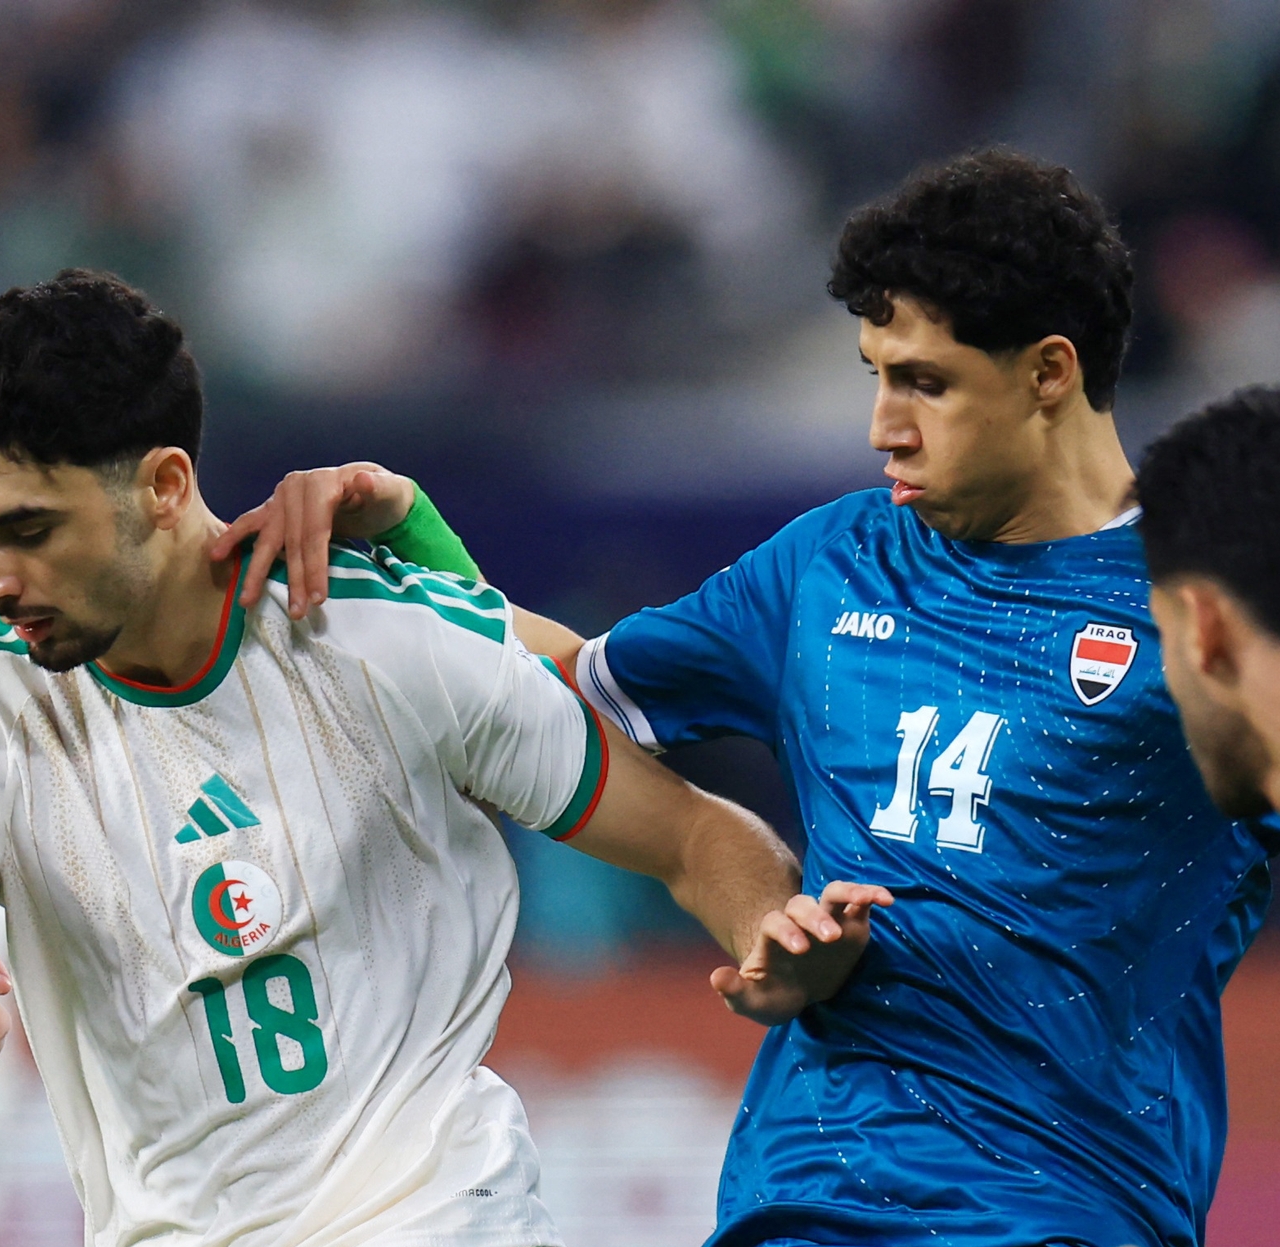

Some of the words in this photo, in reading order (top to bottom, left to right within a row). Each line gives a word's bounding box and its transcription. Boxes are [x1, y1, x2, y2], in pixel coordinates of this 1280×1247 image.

[831, 611, 896, 640] JAKO
[1090, 627, 1127, 641] IRAQ
[869, 705, 1005, 854] 14
[214, 922, 271, 948] ALGERIA
[188, 954, 328, 1104] 18
